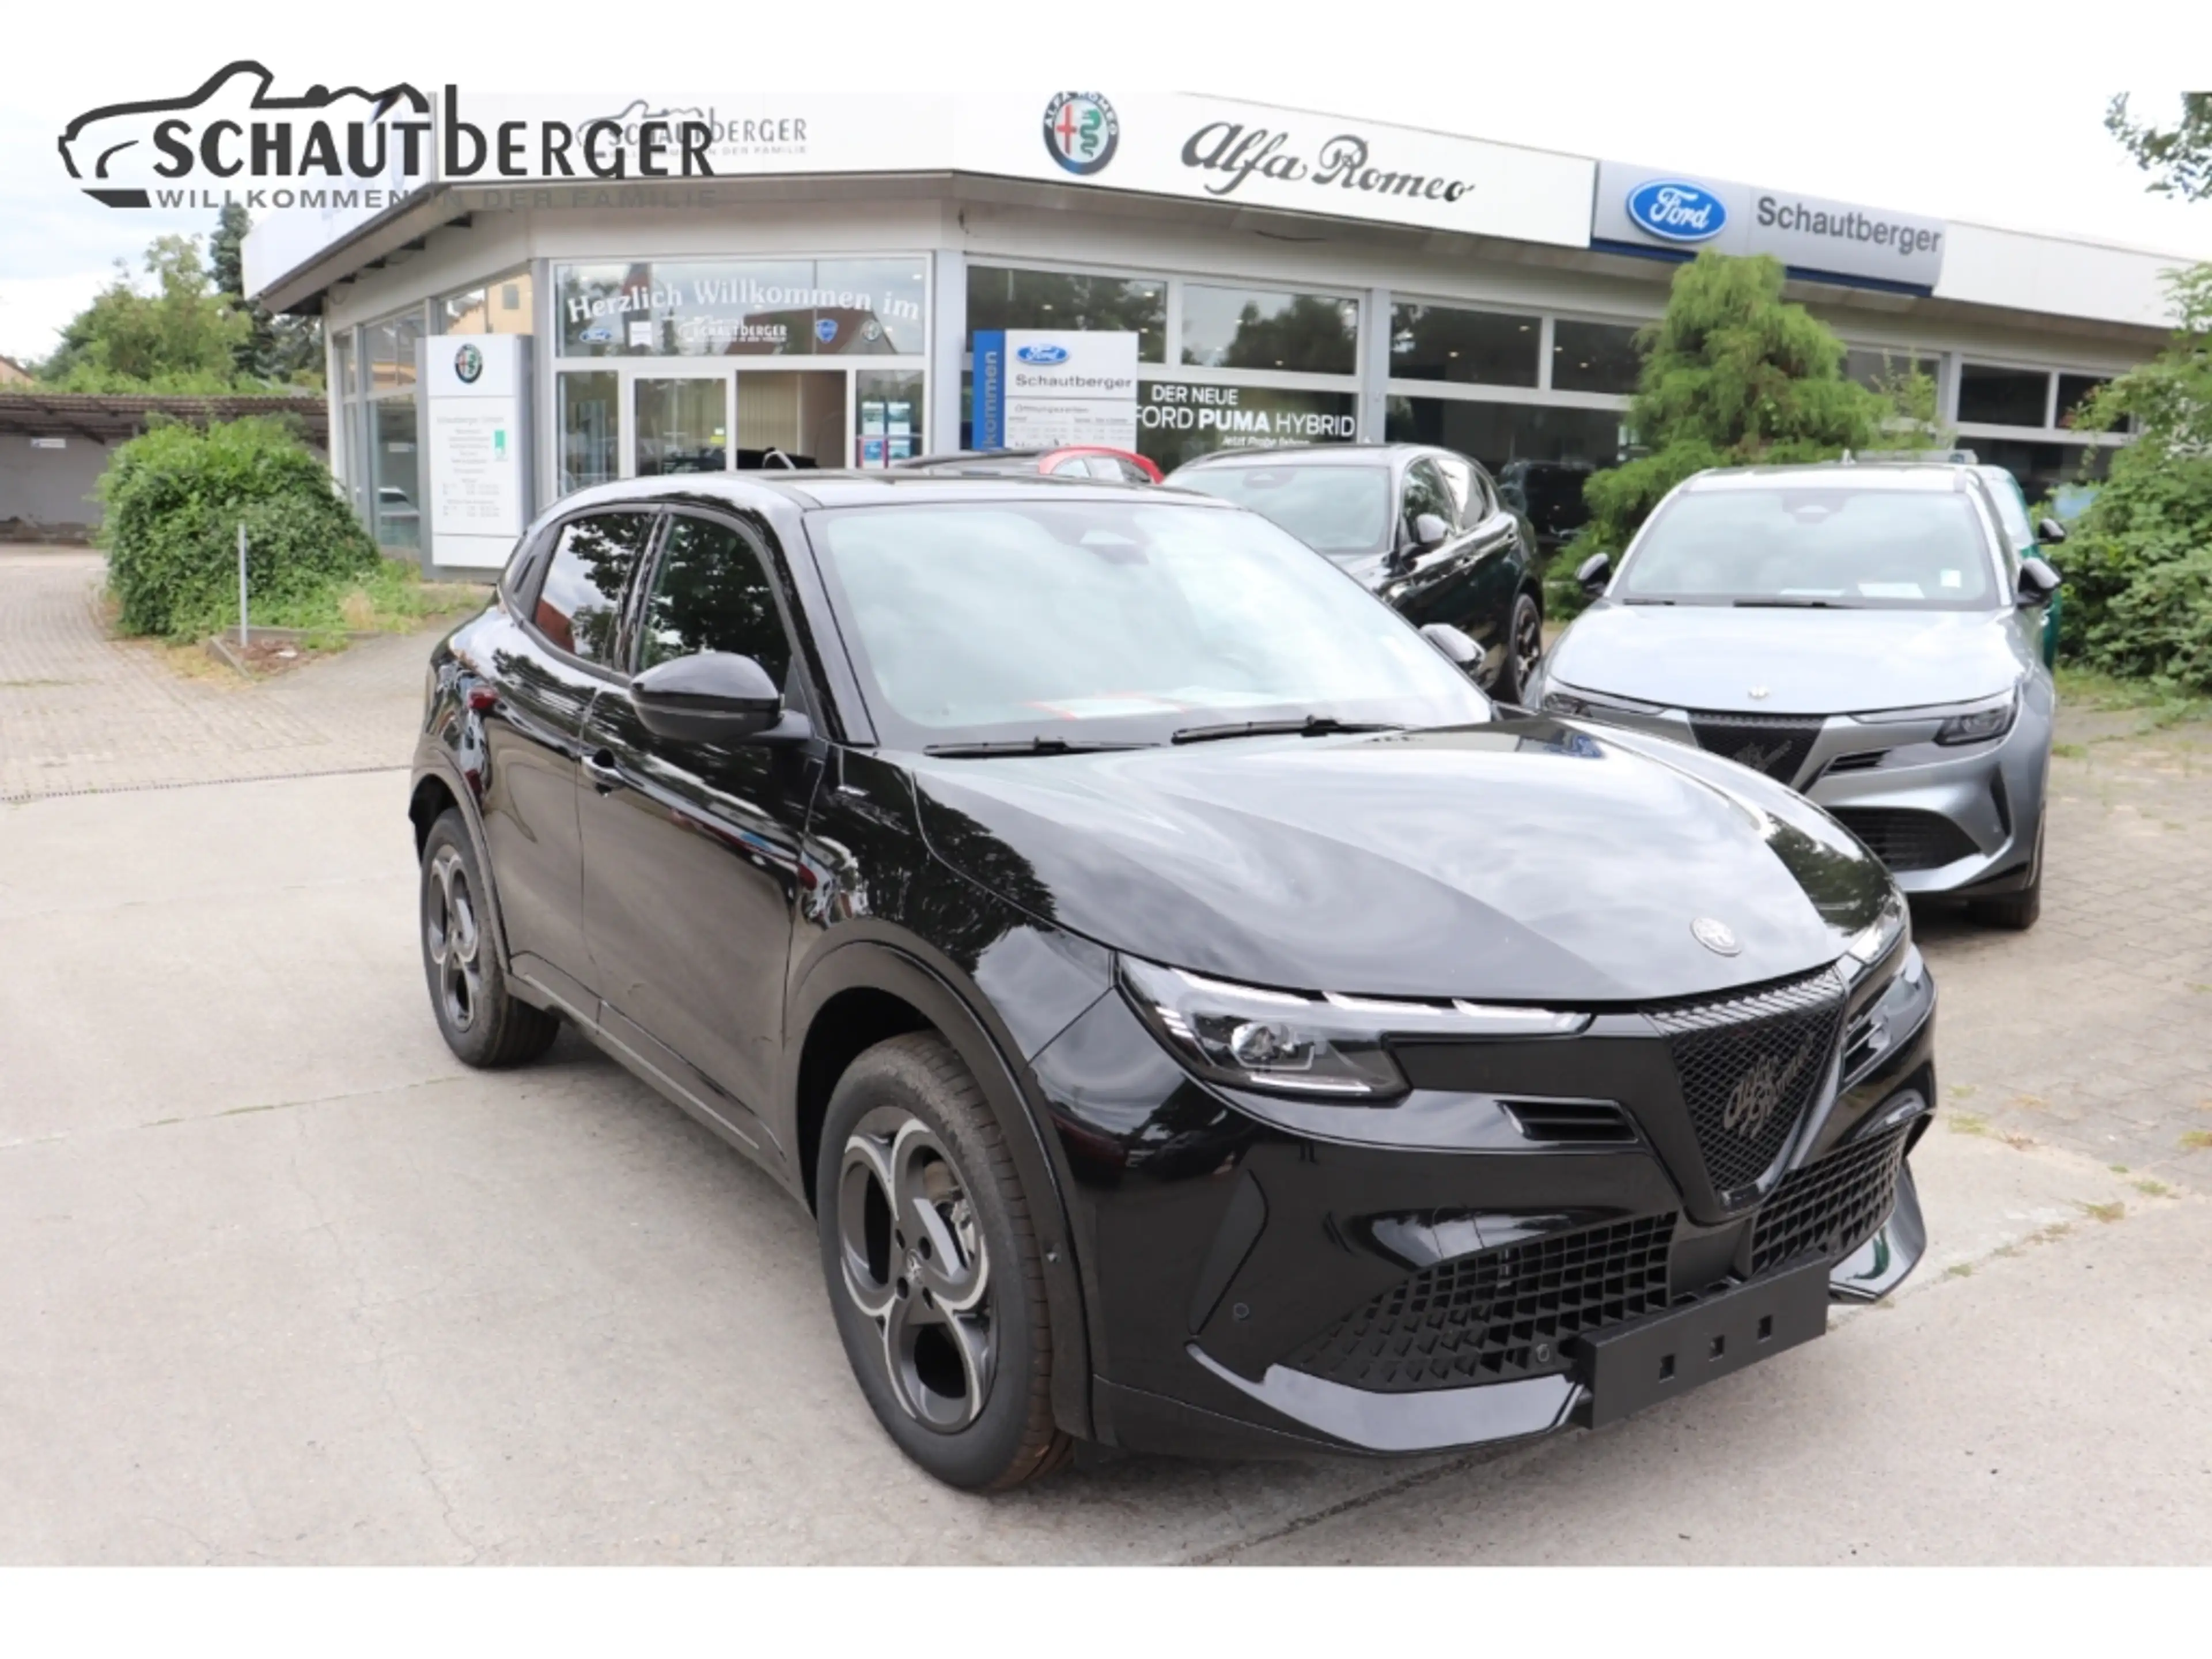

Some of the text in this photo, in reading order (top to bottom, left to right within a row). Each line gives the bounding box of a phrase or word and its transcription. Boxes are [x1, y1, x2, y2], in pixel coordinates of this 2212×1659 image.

[1181, 120, 1475, 202] Alfa Romeo
[1649, 187, 1711, 230] Ford
[1757, 196, 1944, 255] Schautberger
[567, 280, 920, 323] Herzlich Willkommen im
[1015, 374, 1132, 390] Schautberger
[1152, 385, 1239, 406] DER NEUE
[1199, 409, 1271, 433] PUMA
[1276, 412, 1355, 437] HYBRID
